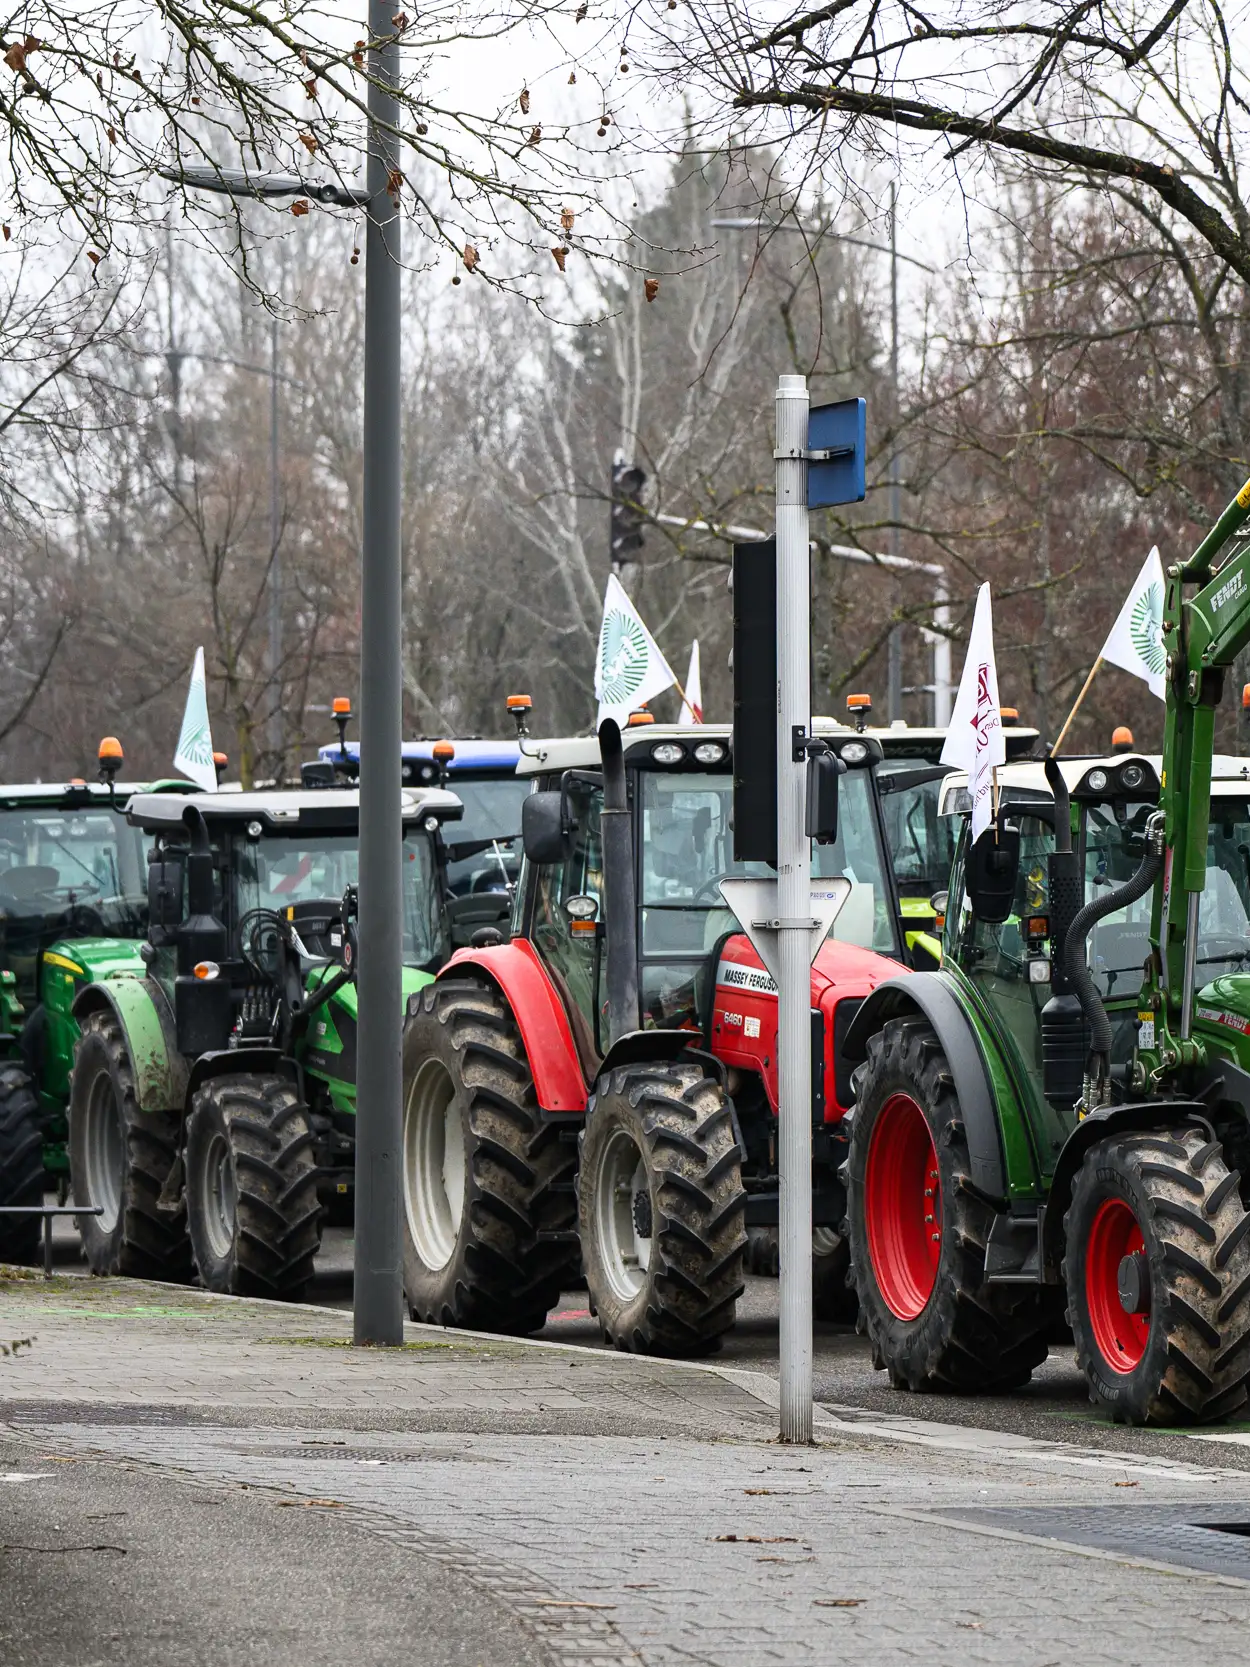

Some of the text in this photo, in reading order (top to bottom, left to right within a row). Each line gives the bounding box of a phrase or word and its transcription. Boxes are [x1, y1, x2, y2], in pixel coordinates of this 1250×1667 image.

[1210, 568, 1244, 613] FENDT
[723, 968, 750, 986] MASSEY
[723, 1011, 743, 1027] 6460
